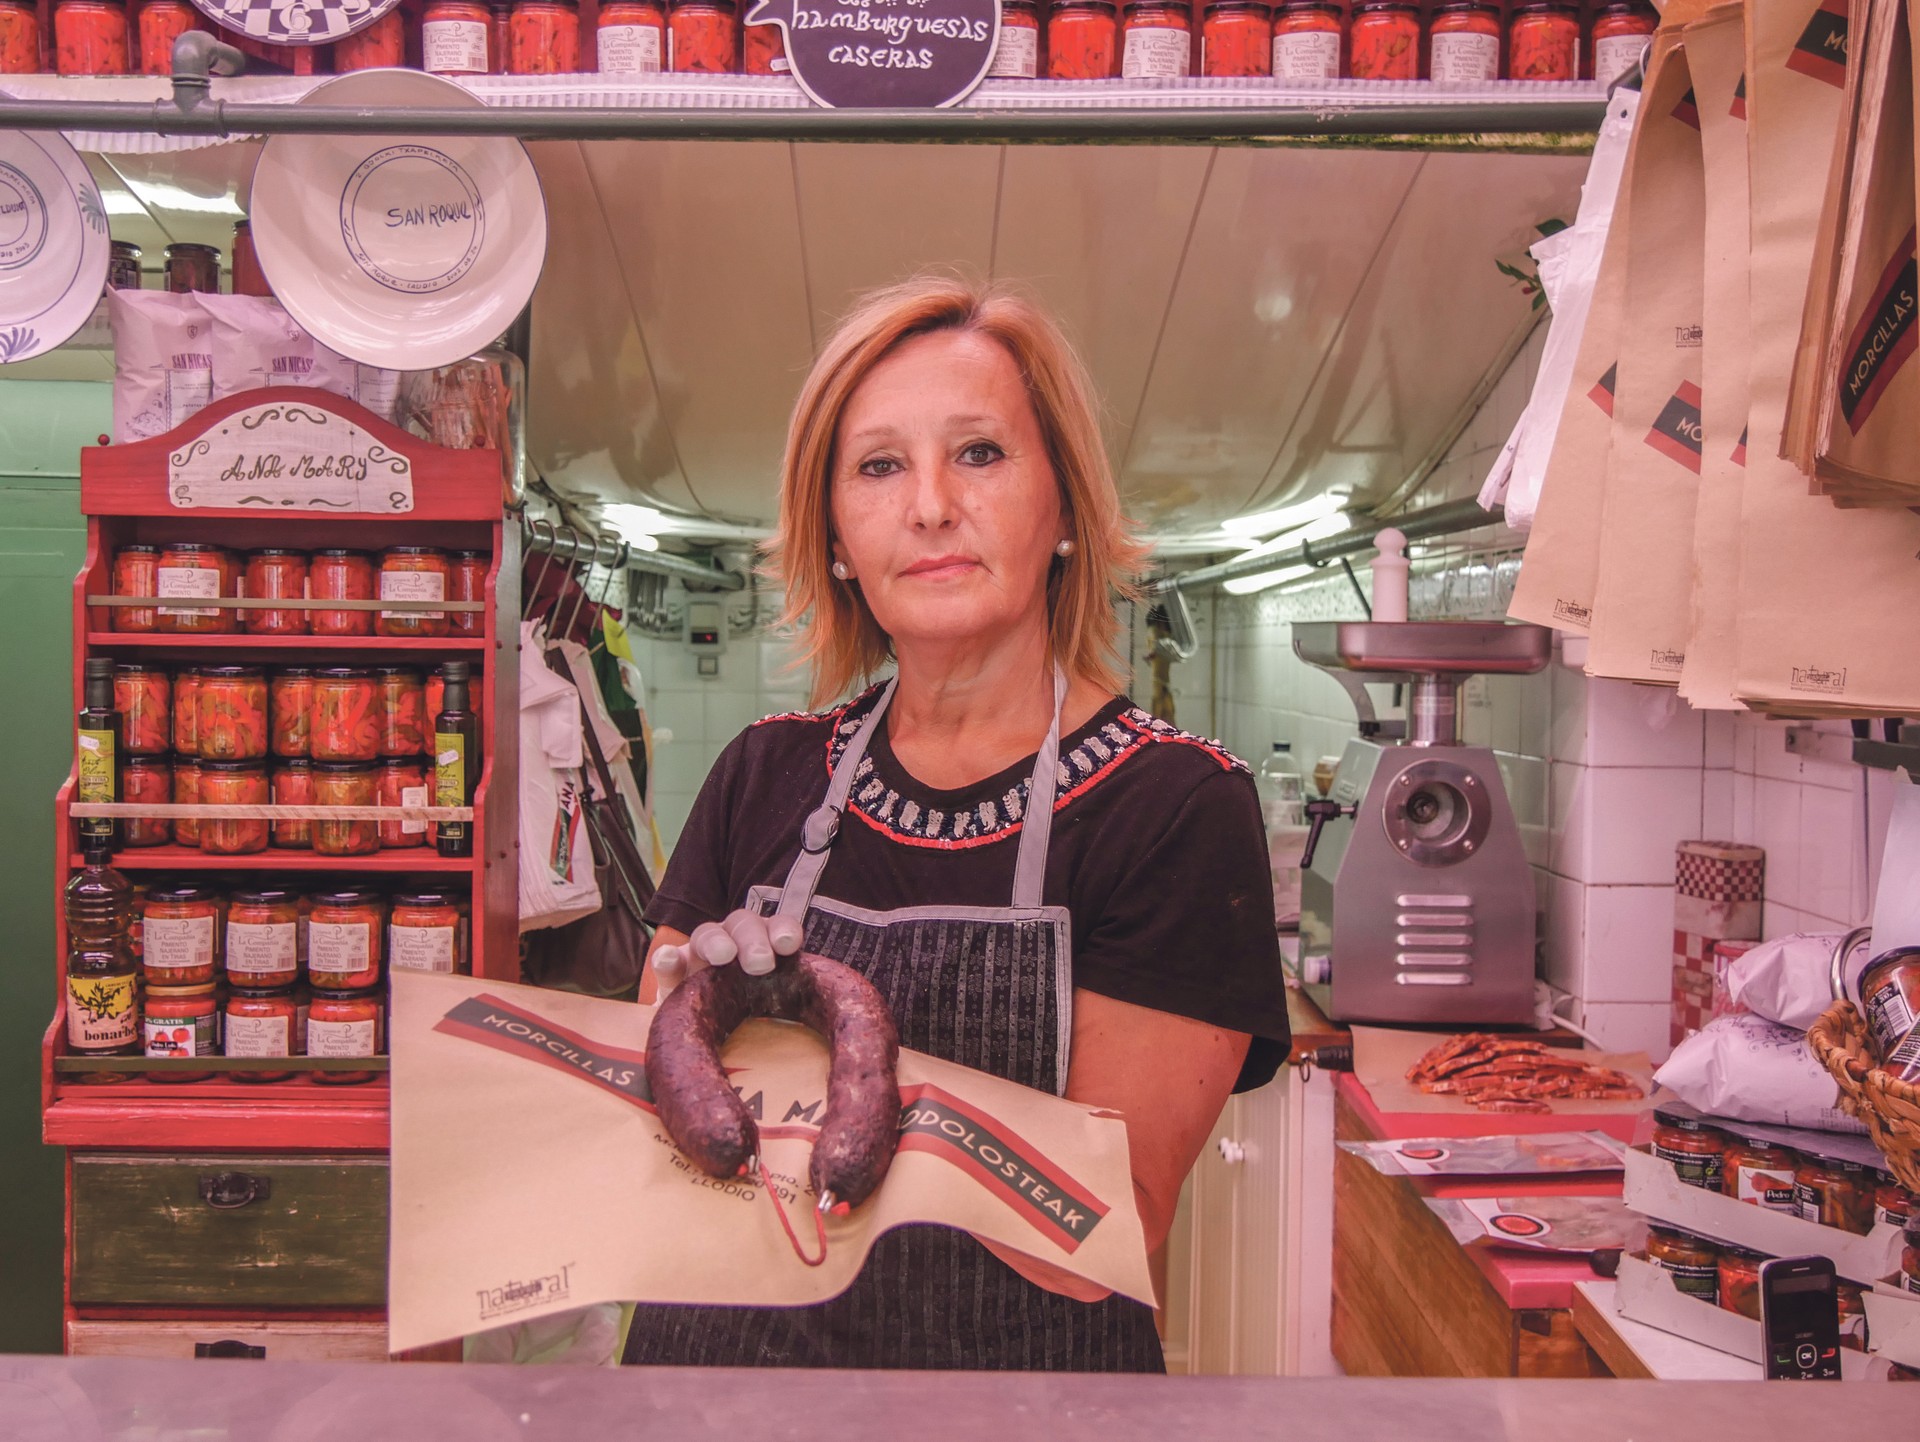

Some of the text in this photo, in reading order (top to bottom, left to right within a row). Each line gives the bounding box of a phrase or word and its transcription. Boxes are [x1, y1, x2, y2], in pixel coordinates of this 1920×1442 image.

[279, 2, 313, 32] 6
[384, 204, 424, 227] SAN
[1849, 290, 1914, 396] MORCILLAS
[172, 353, 187, 369] SAN
[272, 356, 288, 373] SAN
[220, 454, 367, 481] ANA MARY
[482, 1013, 636, 1087] MORCILLAS
[692, 1177, 756, 1201] LLODIO
[1766, 1190, 1790, 1199] Pedro
[1801, 1352, 1812, 1360] OK
